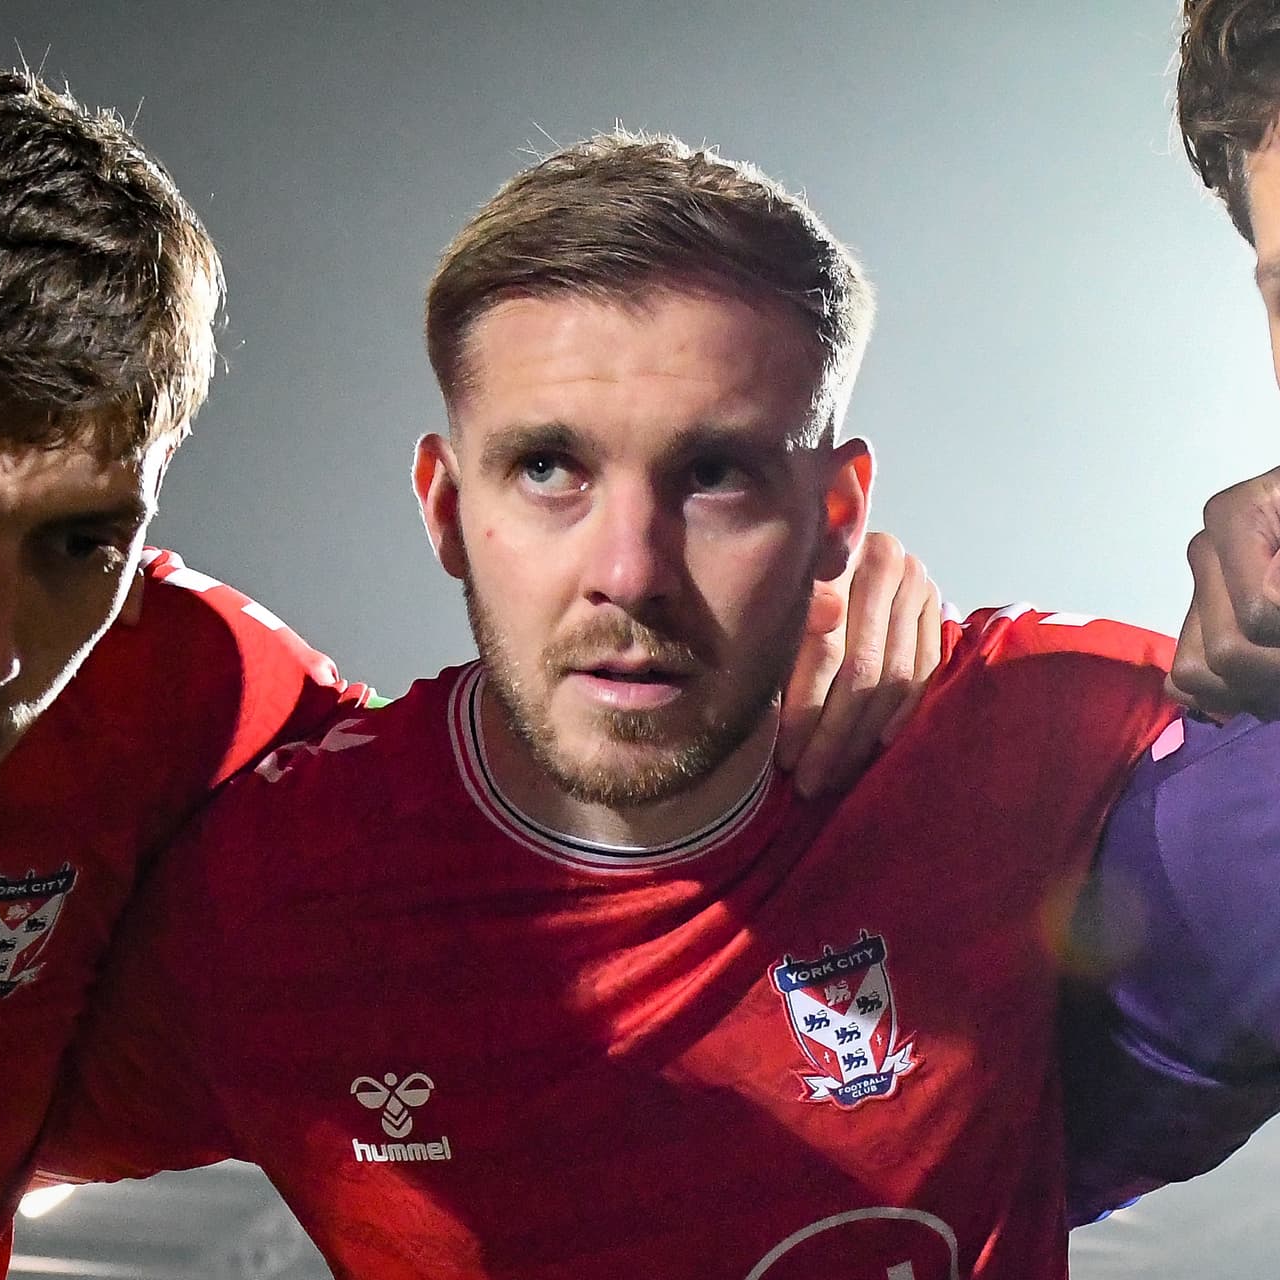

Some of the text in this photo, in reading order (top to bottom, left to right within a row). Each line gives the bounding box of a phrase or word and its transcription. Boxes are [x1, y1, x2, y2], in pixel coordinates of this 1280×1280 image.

[31, 878, 67, 892] CITY
[786, 948, 874, 985] YORK CITY
[838, 1074, 889, 1095] FOOTBALL
[851, 1084, 878, 1098] CLUB
[352, 1136, 451, 1163] hummel
